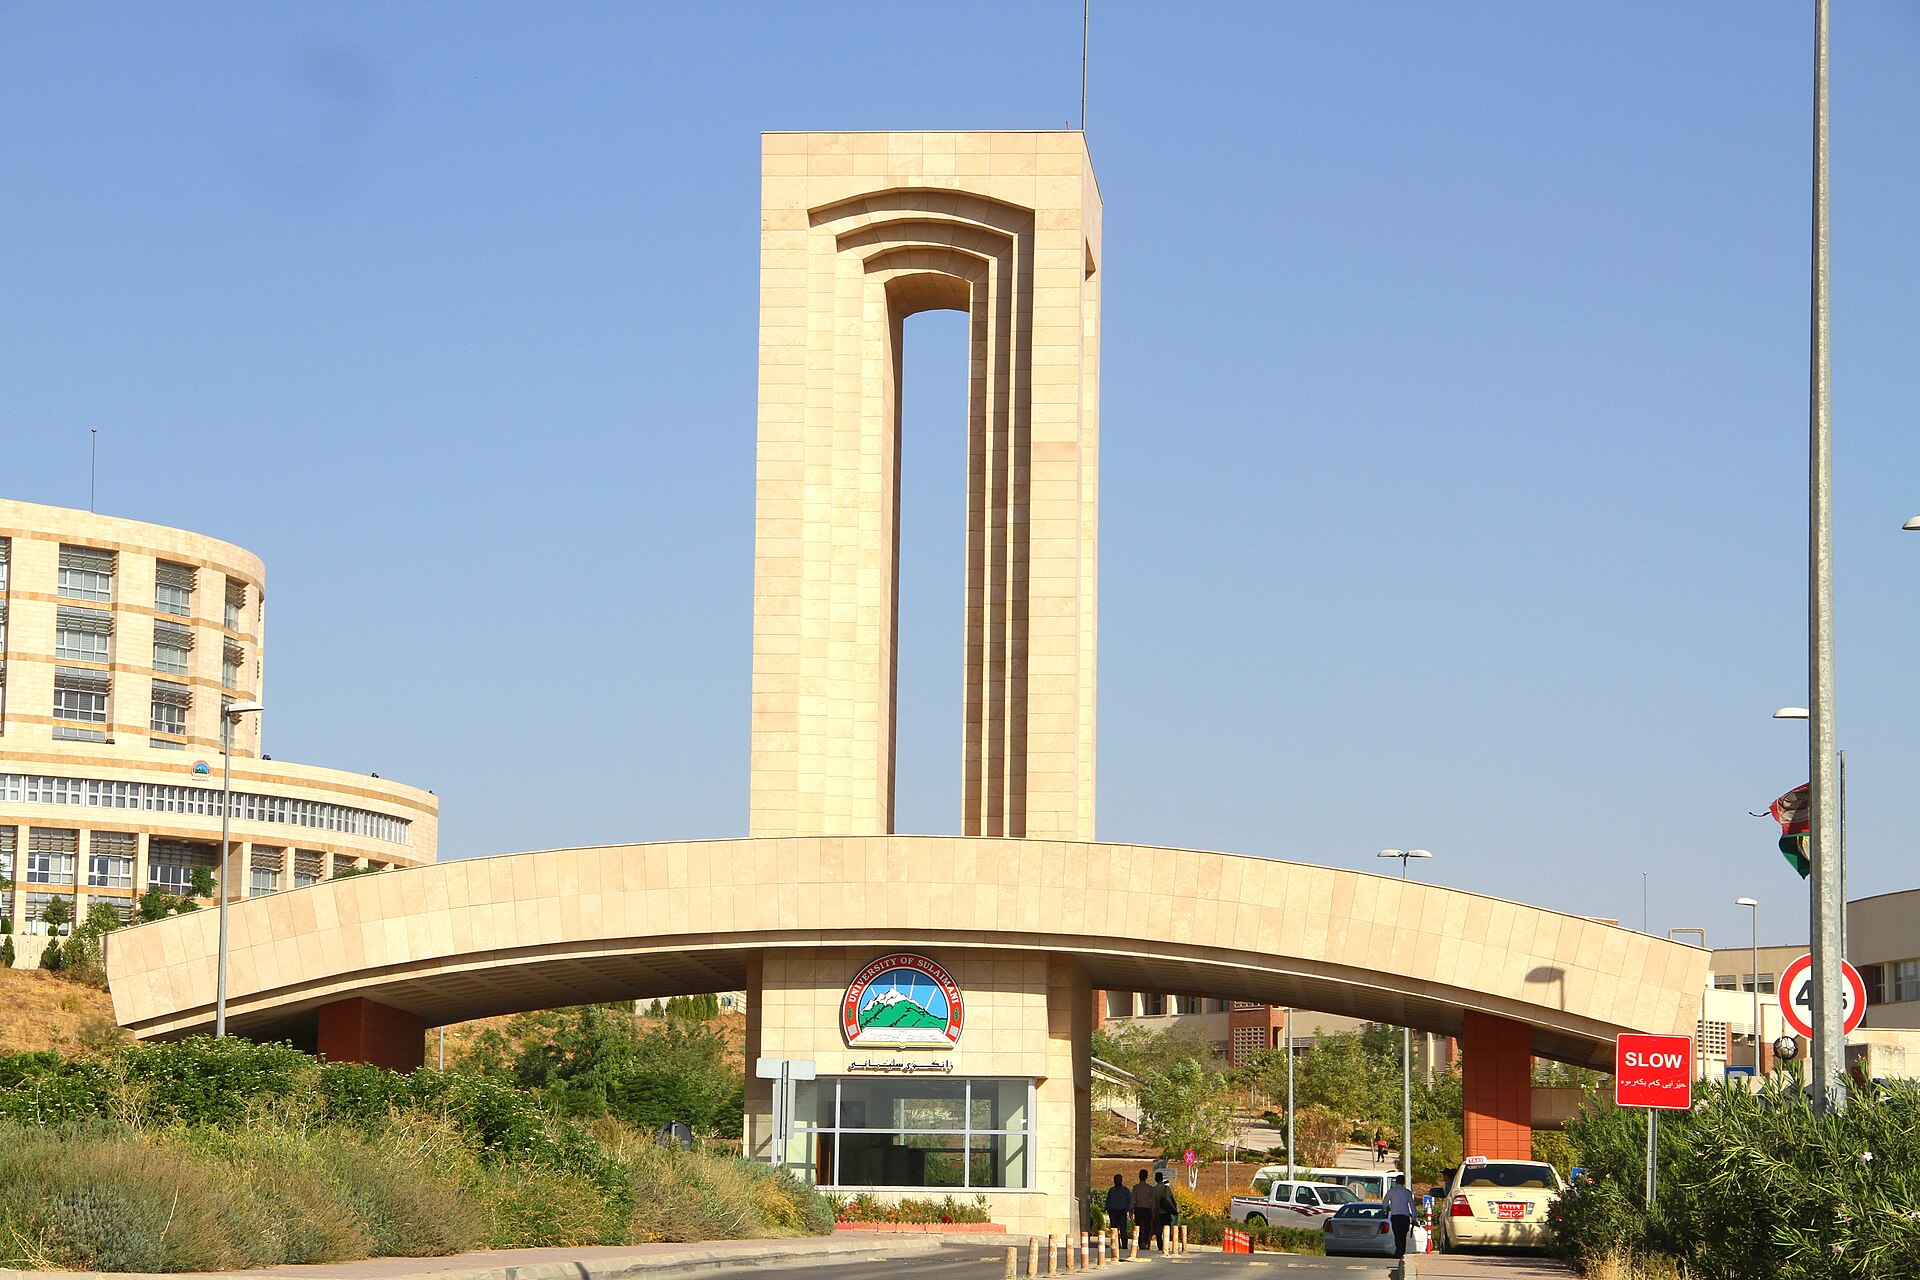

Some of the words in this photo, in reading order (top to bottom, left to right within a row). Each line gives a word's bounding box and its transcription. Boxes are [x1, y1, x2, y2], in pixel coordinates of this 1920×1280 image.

[849, 958, 897, 1003] UNIVERSITY
[900, 957, 914, 965] OF
[918, 960, 960, 1004] SULAIMANI
[1625, 1052, 1683, 1069] SLOW
